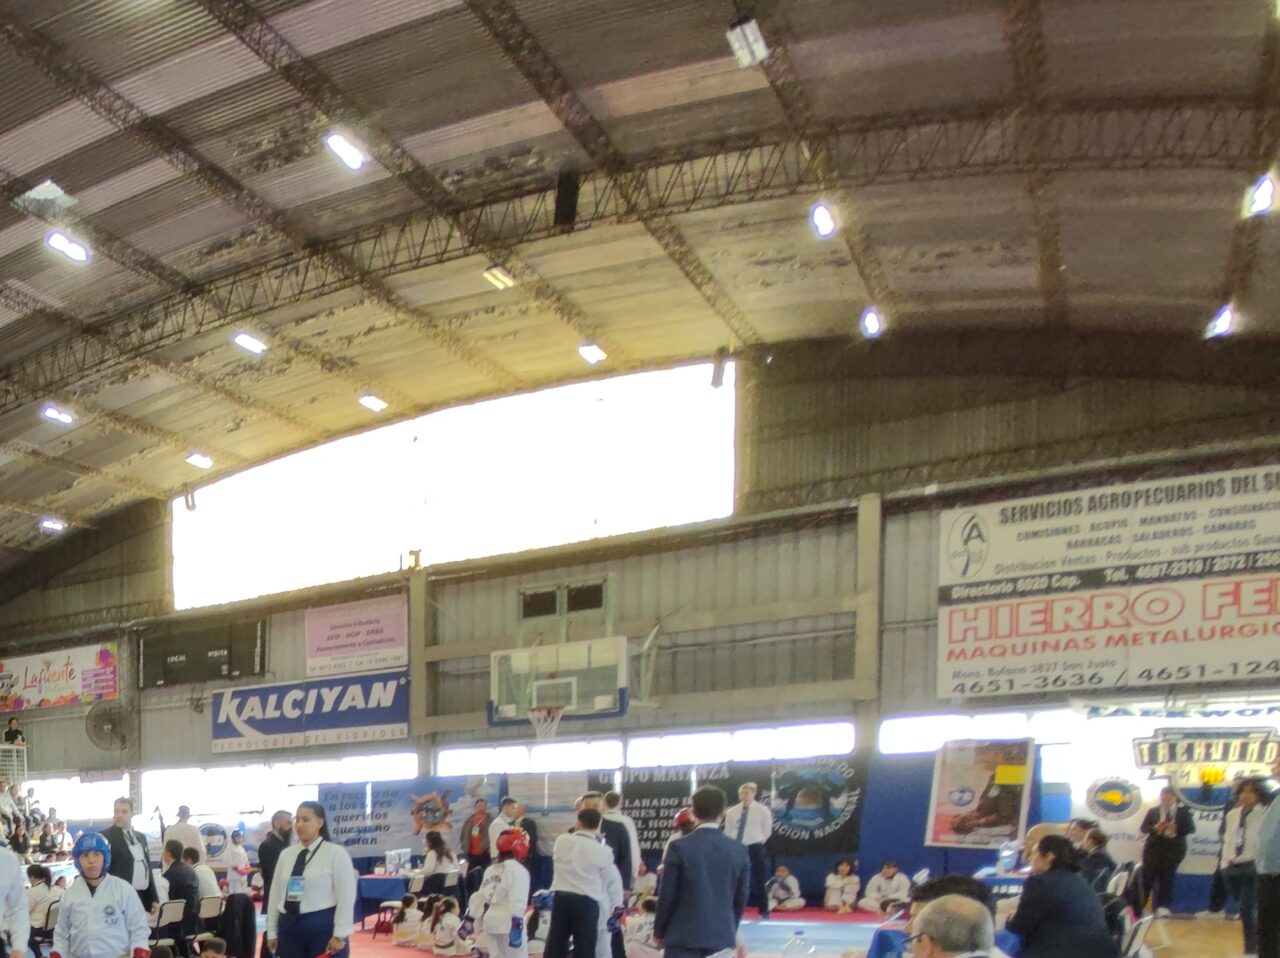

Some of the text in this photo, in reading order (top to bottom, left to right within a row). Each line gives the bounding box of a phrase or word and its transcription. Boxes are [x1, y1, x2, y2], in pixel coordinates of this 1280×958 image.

[999, 497, 1083, 526] SERVICIOS
[1086, 477, 1227, 515] AGROPECUARIOS
[1230, 474, 1259, 496] DEL
[948, 586, 1186, 645] HIERRO
[945, 635, 1097, 663] MAQUINAS
[217, 680, 398, 727] KALCIYAN
[951, 671, 1104, 695] 4651-3636
